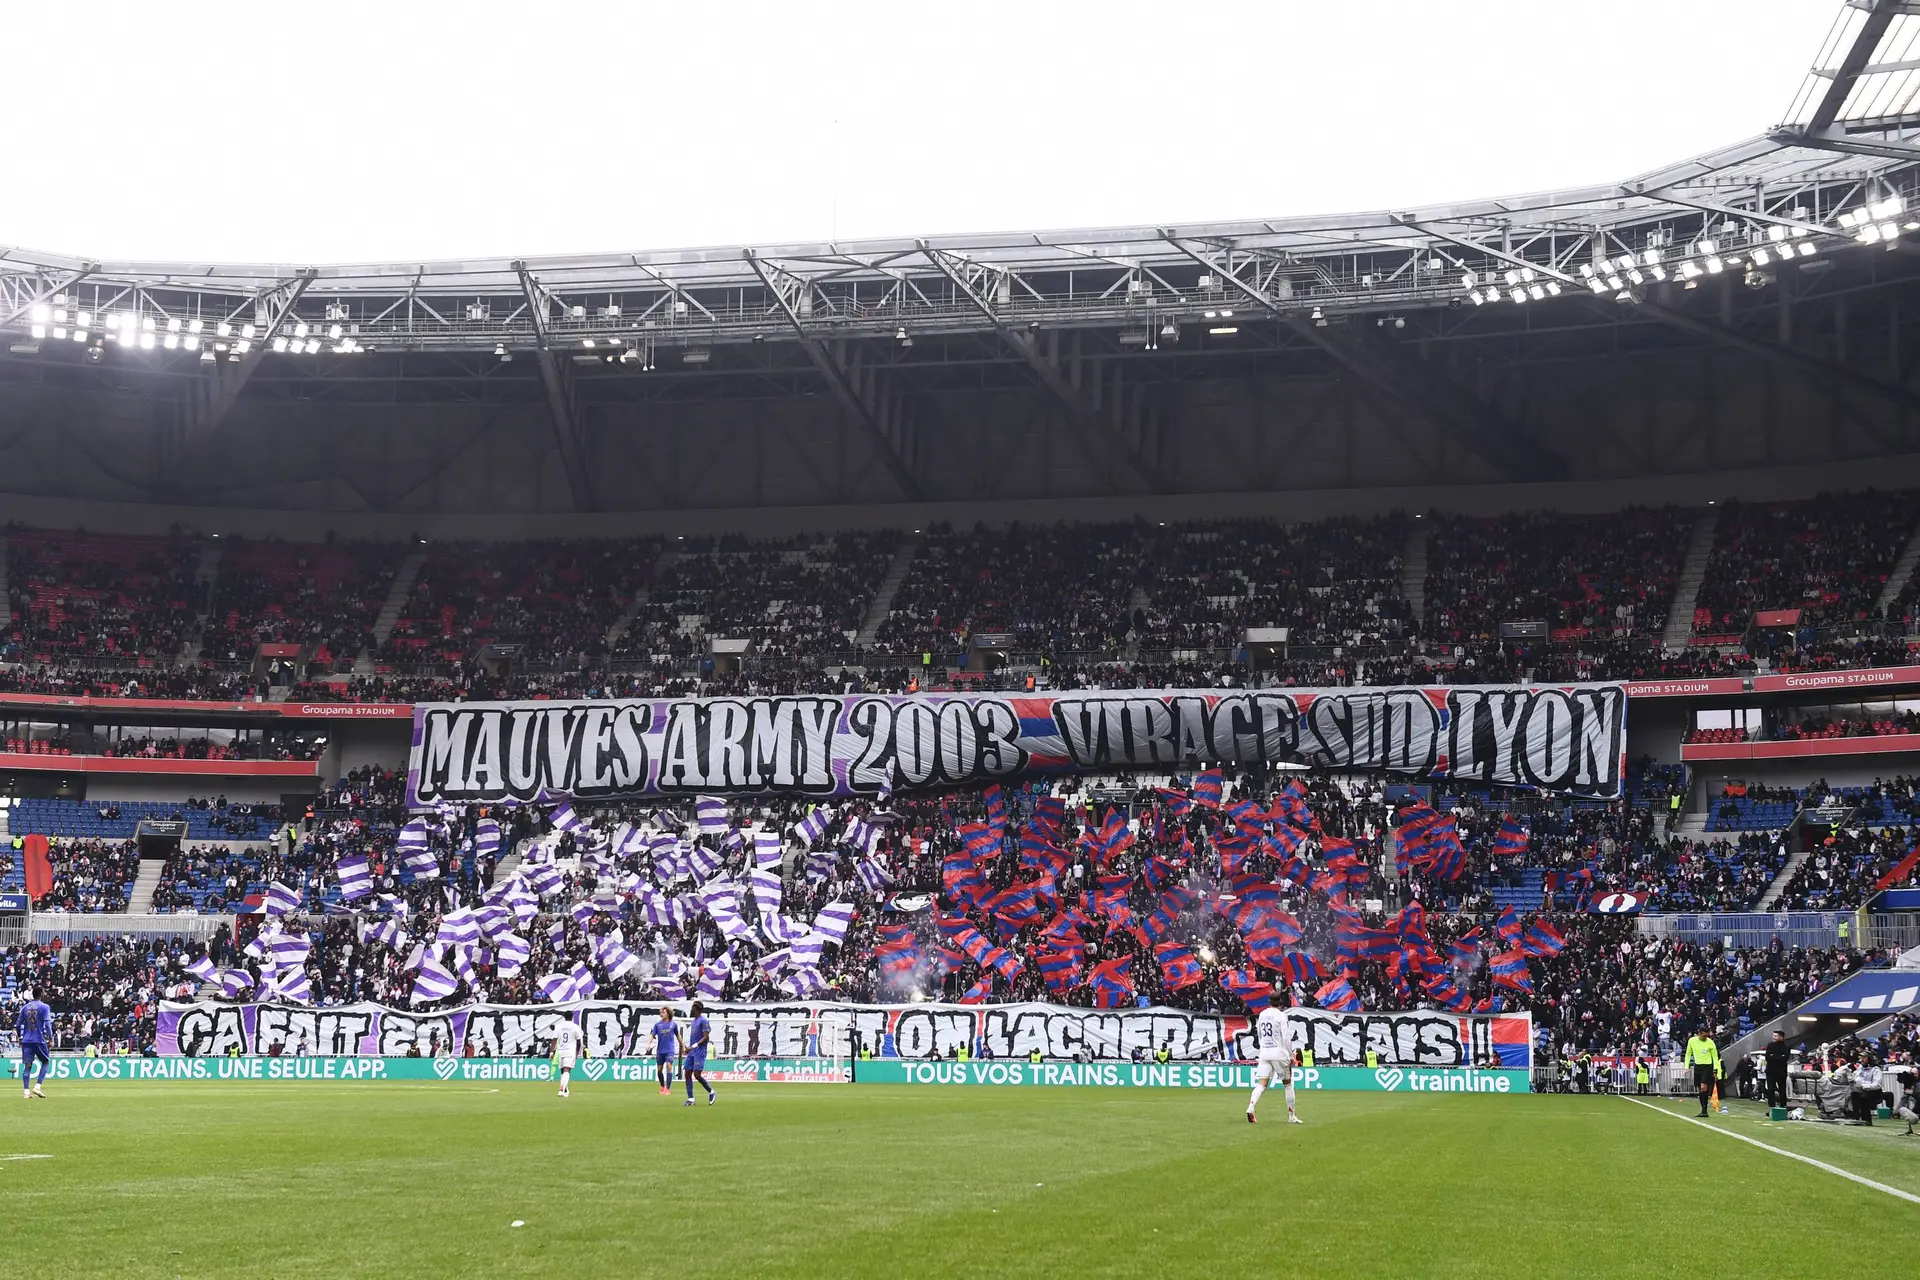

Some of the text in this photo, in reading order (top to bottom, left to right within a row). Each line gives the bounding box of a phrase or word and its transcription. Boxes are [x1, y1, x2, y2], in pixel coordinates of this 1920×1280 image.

[1628, 683, 1709, 694] pama STADIUM
[1785, 672, 1894, 687] Groupama STADIUM
[302, 705, 353, 715] Groupama
[420, 690, 1618, 793] MAUVES ARMY 2003 VIRAGE SUD LYON
[255, 1005, 371, 1054] FAIT
[896, 1009, 975, 1058] ON
[984, 1011, 1225, 1060] LACHERA
[562, 1032, 569, 1044] 9
[1261, 1022, 1273, 1037] 33
[76, 1058, 121, 1078] VOS
[126, 1058, 212, 1078] TRAINS.
[218, 1058, 263, 1079] UNE
[268, 1058, 336, 1078] SEULE
[340, 1058, 388, 1079] APP.
[462, 1058, 551, 1080] trainline
[784, 1072, 830, 1082] Emirates
[902, 1063, 967, 1084] TOUS
[973, 1063, 1024, 1084] VOS
[1027, 1064, 1125, 1085] TRAINS.
[1131, 1065, 1179, 1086] UNE
[1187, 1065, 1261, 1088] SEULE
[1408, 1069, 1511, 1092] trainline
